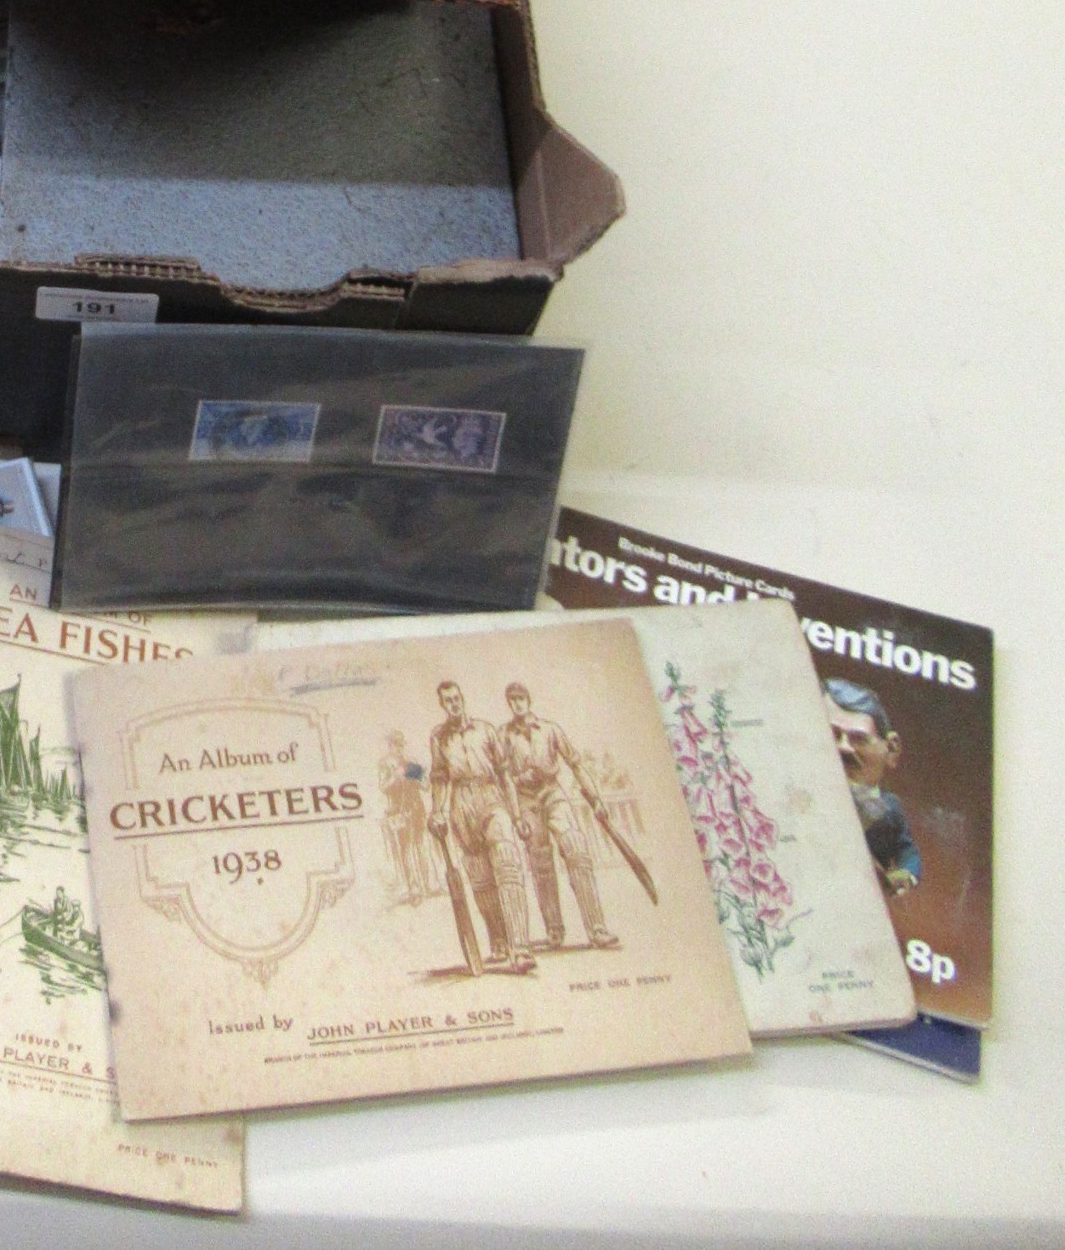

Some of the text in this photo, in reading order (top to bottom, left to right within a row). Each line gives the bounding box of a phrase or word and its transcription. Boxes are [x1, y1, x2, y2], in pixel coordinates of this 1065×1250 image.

[73, 301, 115, 314] 191
[667, 553, 703, 575] Bond
[9, 584, 37, 600] AN
[159, 741, 299, 775] An Album of
[109, 782, 363, 831] CRICKETERS
[212, 849, 282, 885] 1938
[905, 939, 956, 984] 8p
[208, 1008, 514, 1040] Issued by JOHN PLAYER & SONS
[15, 1033, 60, 1049] ISSUED
[3, 1047, 70, 1070] PLAYER
[81, 1061, 93, 1075] &
